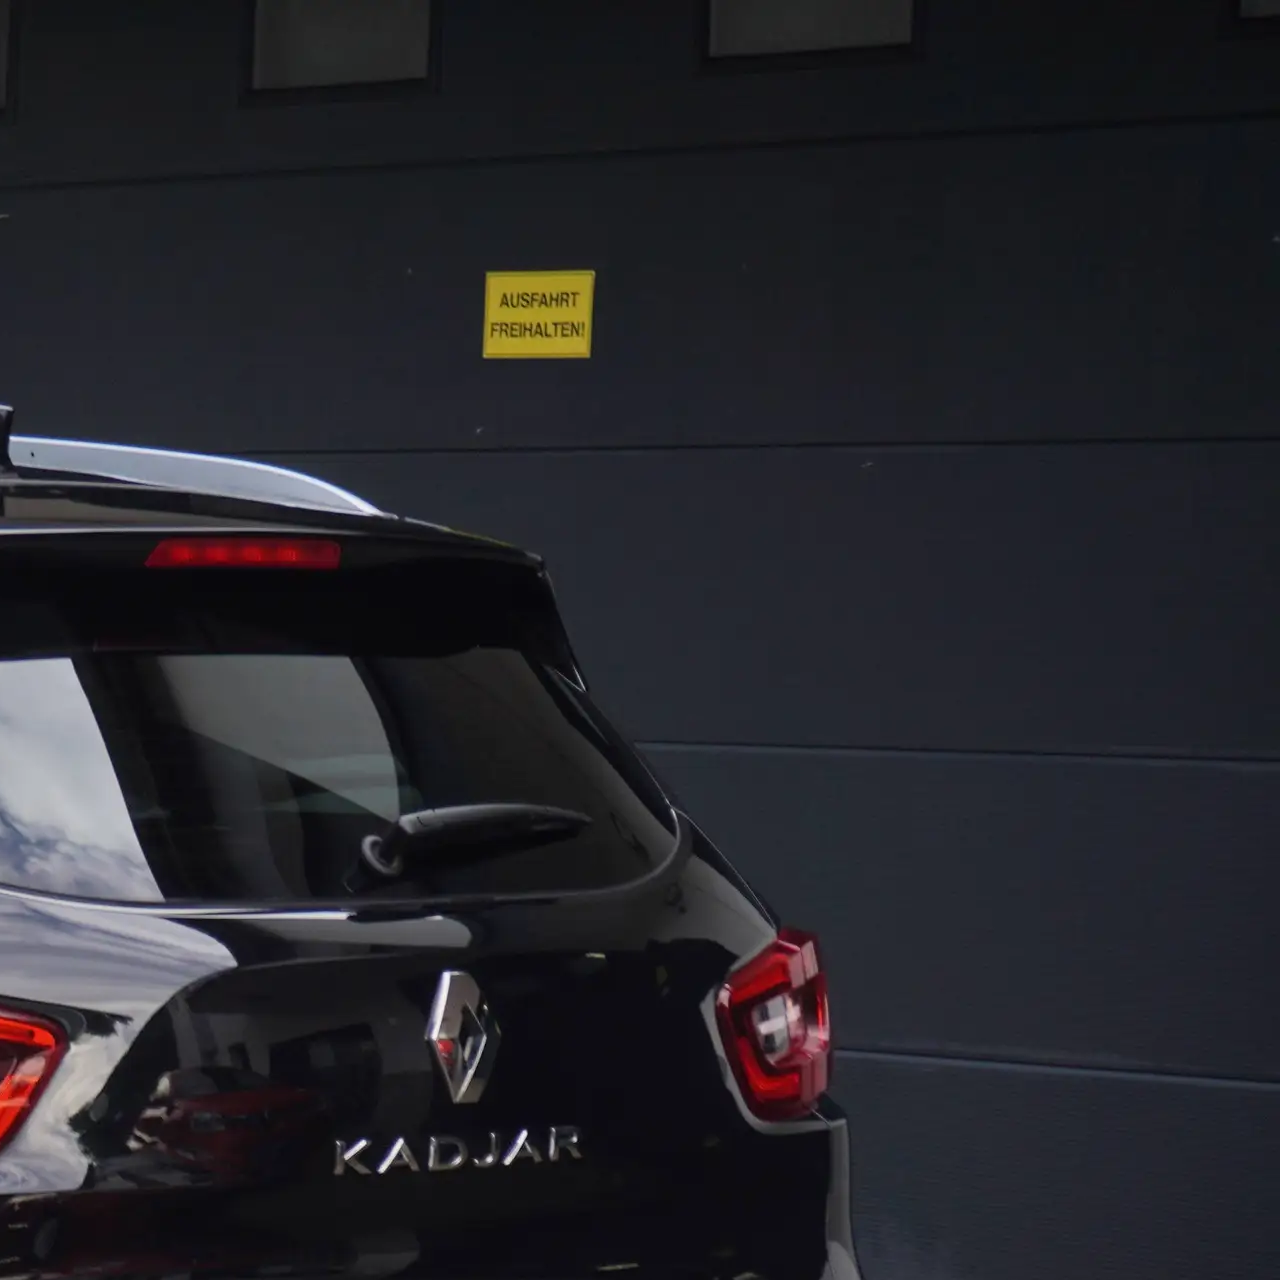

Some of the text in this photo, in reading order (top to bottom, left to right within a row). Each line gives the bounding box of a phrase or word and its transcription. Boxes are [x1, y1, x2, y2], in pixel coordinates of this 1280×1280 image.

[499, 291, 580, 309] AUSFAHRT
[489, 321, 586, 339] FREIHALTEN!
[333, 1126, 583, 1176] KADJAR
